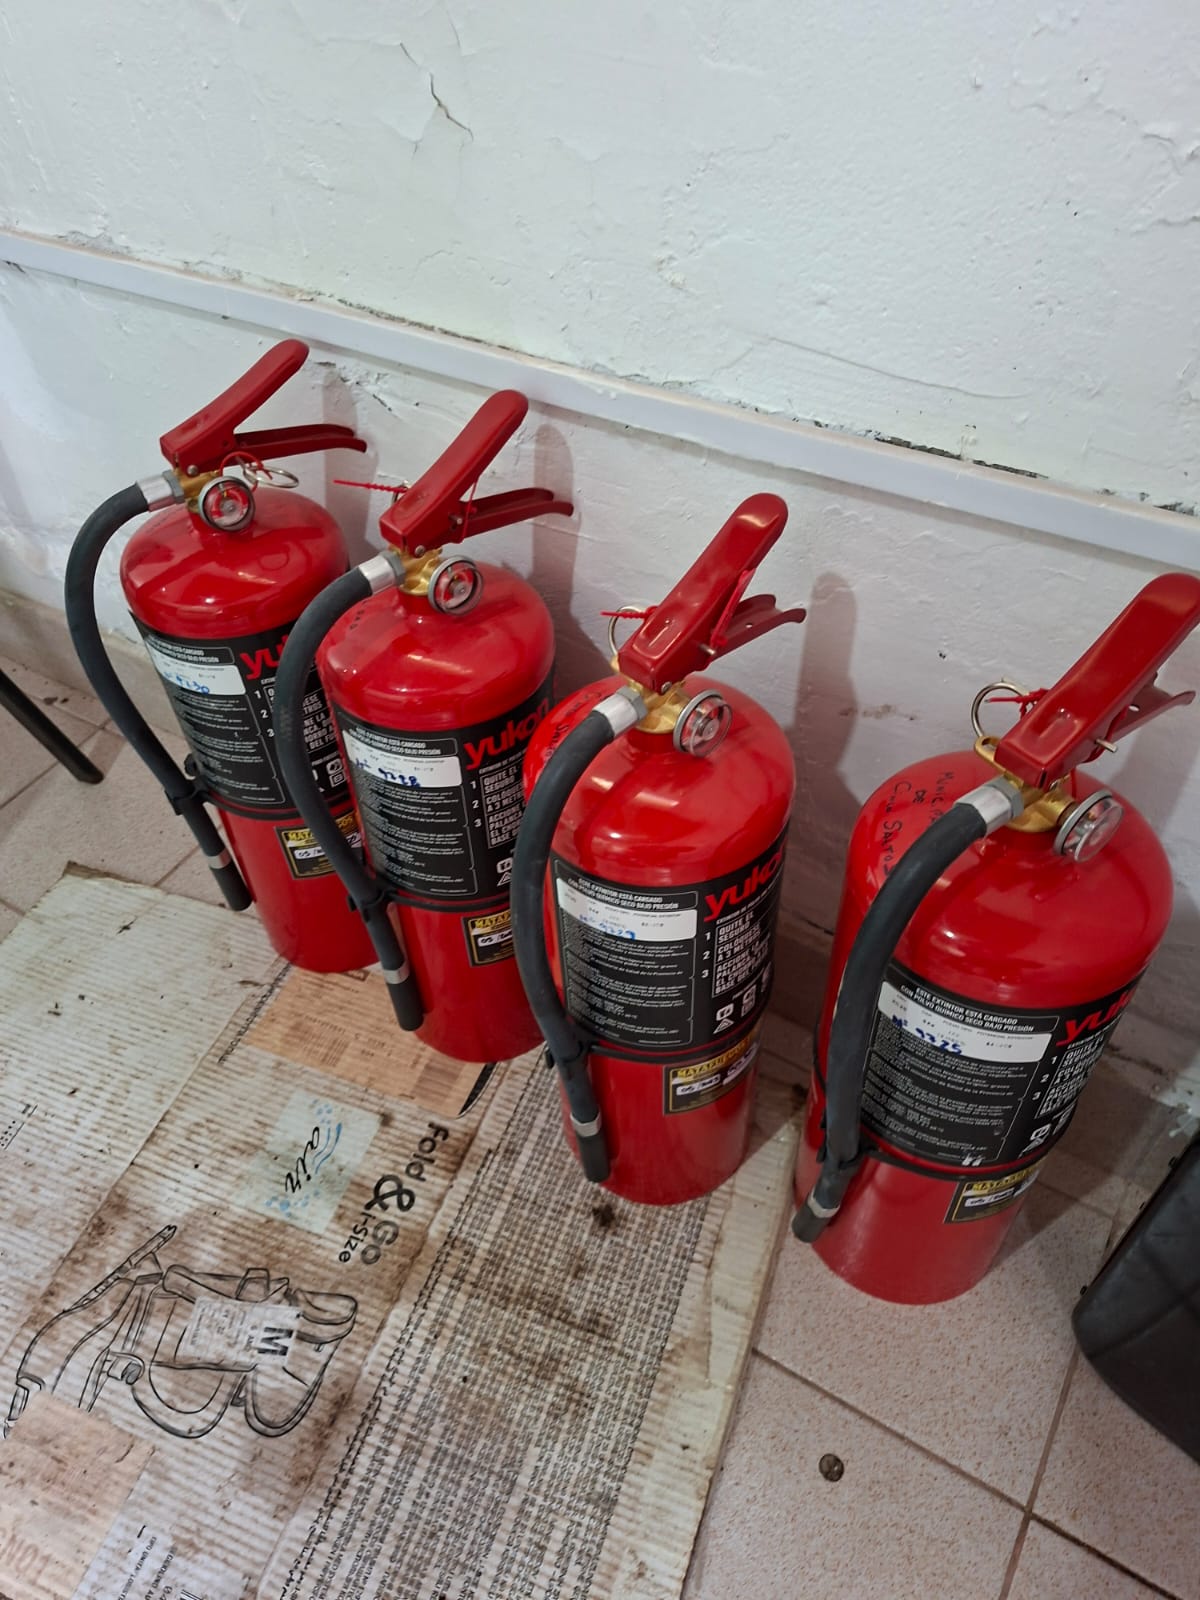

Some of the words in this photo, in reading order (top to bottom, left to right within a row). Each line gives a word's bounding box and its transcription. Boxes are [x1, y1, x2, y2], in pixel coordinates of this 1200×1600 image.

[254, 690, 262, 700] 1
[260, 709, 268, 718] 2
[266, 728, 275, 738] 3
[470, 781, 476, 790] 1
[472, 800, 480, 809] 2
[488, 804, 494, 812] A
[494, 802, 500, 810] 3
[474, 818, 482, 828] 3
[704, 932, 711, 941] 1
[702, 951, 710, 960] 2
[717, 954, 724, 962] A
[726, 950, 732, 958] 3
[701, 970, 709, 978] 3
[900, 984, 914, 999] CON
[913, 993, 934, 1012] POLVO
[964, 1015, 984, 1026] SECO
[984, 1020, 1002, 1030] BAJO
[1002, 1022, 1034, 1032] PRESIÓN
[916, 986, 931, 1000] ESTE
[930, 992, 965, 1014] EXTINTOR
[964, 1008, 982, 1020] ESTÁ
[983, 1014, 1018, 1025] CARGADO
[1051, 1056, 1058, 1064] 1
[1040, 1073, 1050, 1083] 2
[1032, 1091, 1042, 1100] 3
[418, 1122, 449, 1182] Fold
[364, 1174, 416, 1212] &
[360, 1220, 400, 1265] Go
[257, 1323, 293, 1359] M
